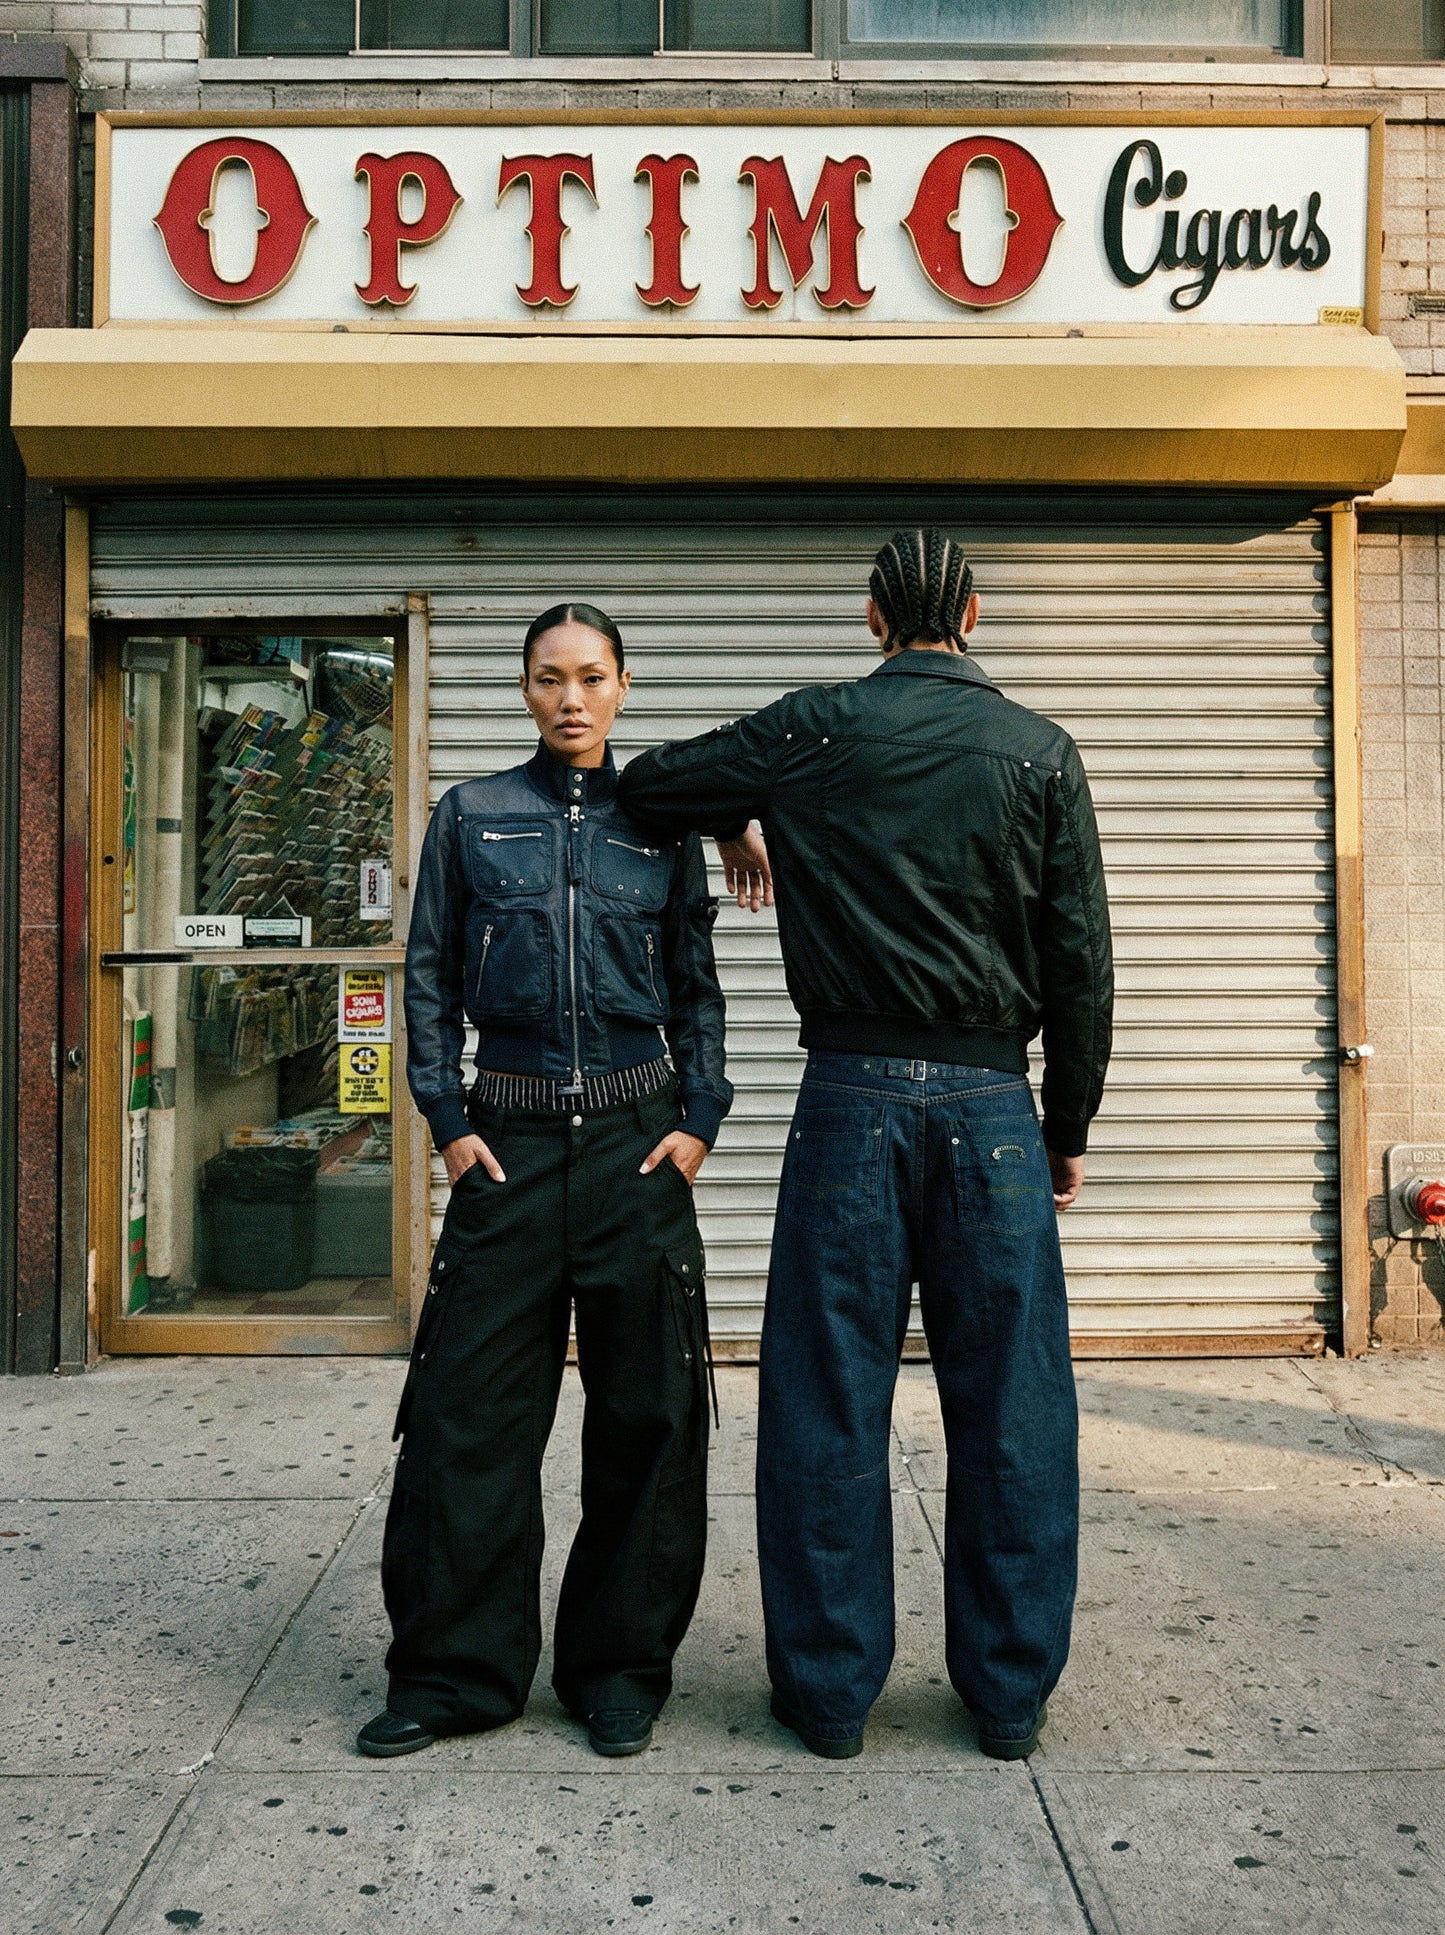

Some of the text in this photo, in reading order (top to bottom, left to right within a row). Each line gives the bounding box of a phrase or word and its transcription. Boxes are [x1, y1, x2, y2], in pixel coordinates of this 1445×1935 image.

[152, 135, 1332, 311] OPTIMO Cigars
[185, 924, 226, 938] OPEN
